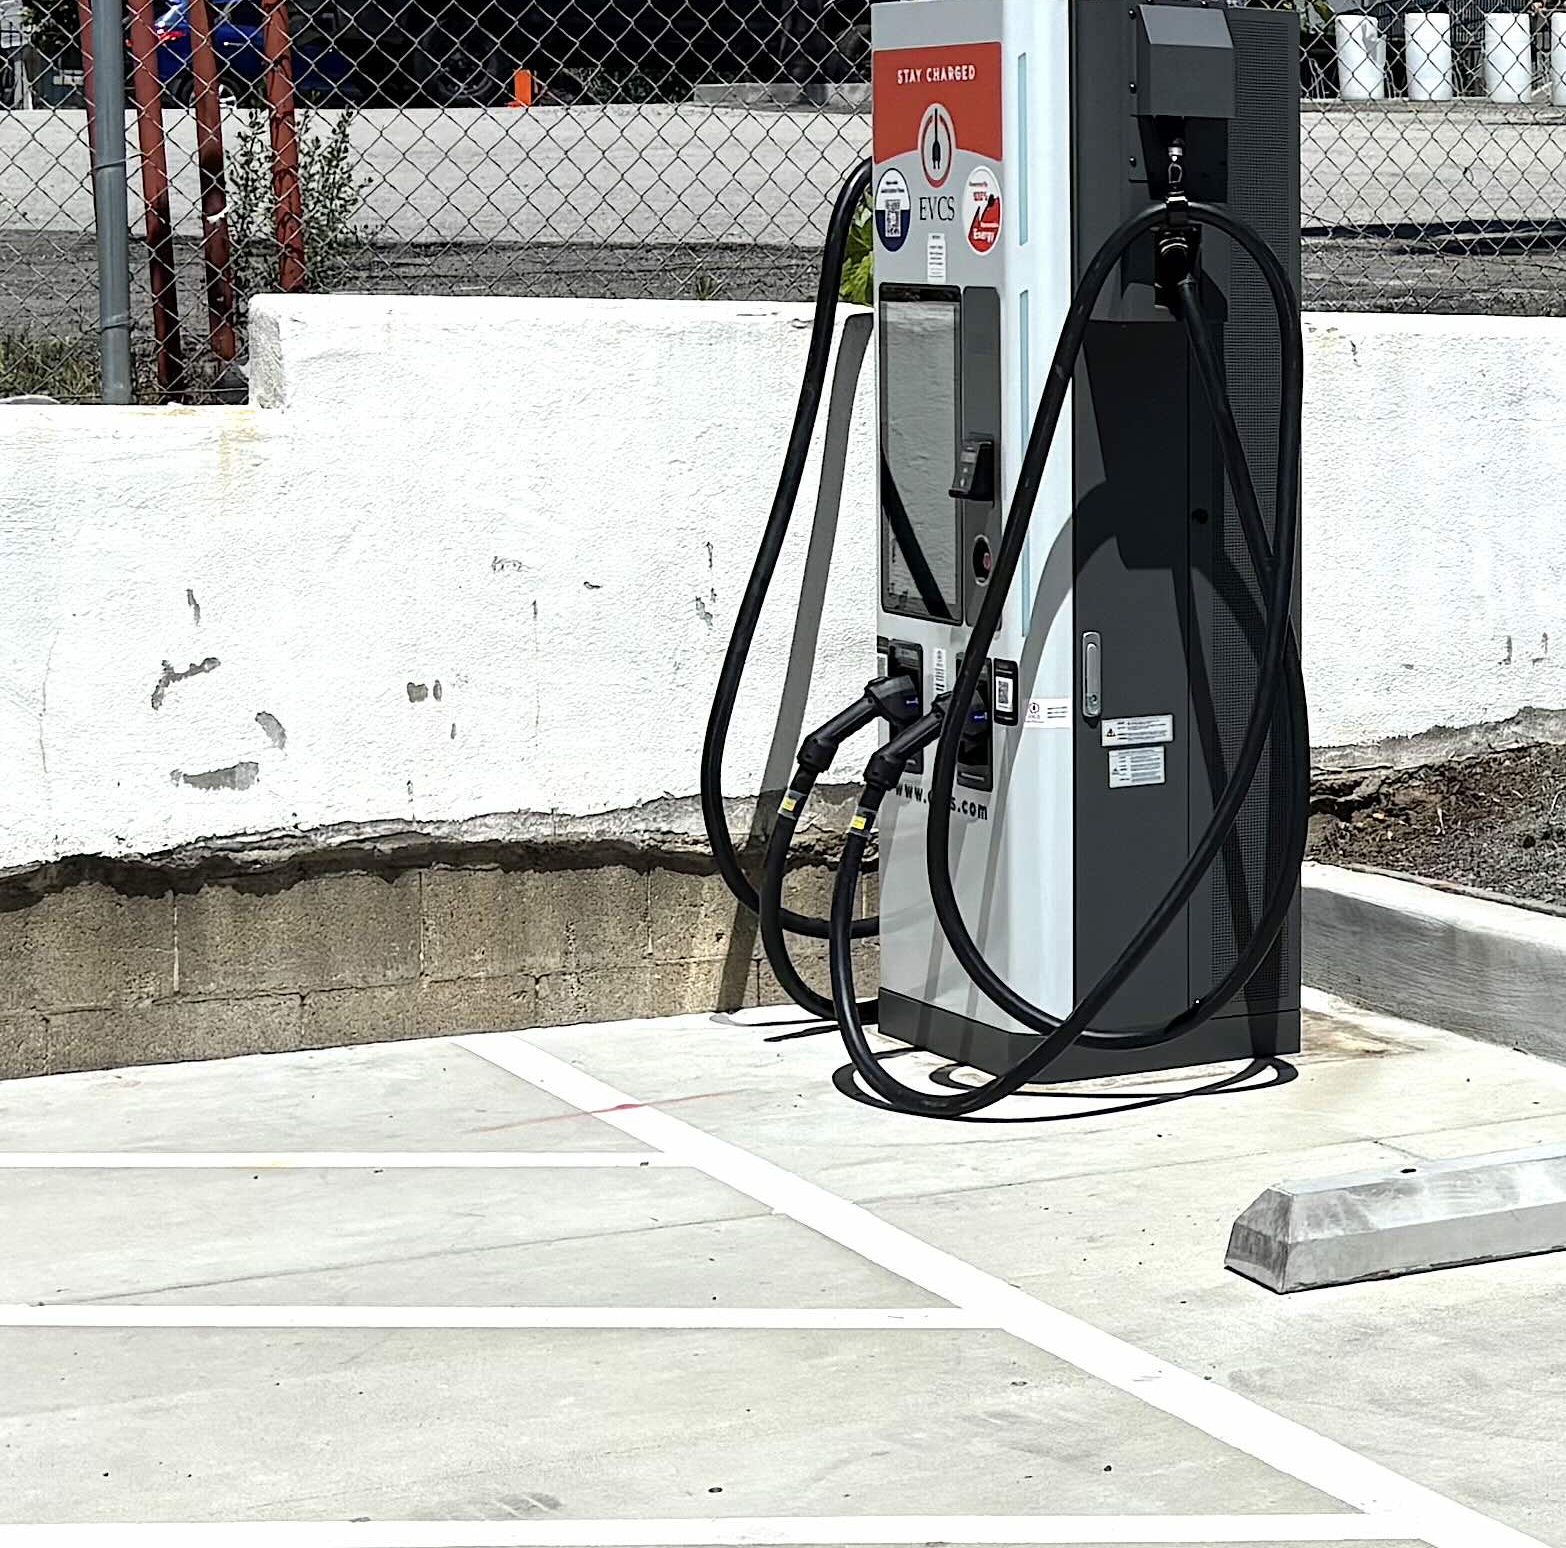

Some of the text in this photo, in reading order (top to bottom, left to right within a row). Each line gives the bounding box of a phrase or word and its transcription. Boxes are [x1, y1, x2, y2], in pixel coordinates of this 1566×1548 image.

[897, 65, 976, 84] STAY CHARGED
[919, 196, 955, 221] EVCS
